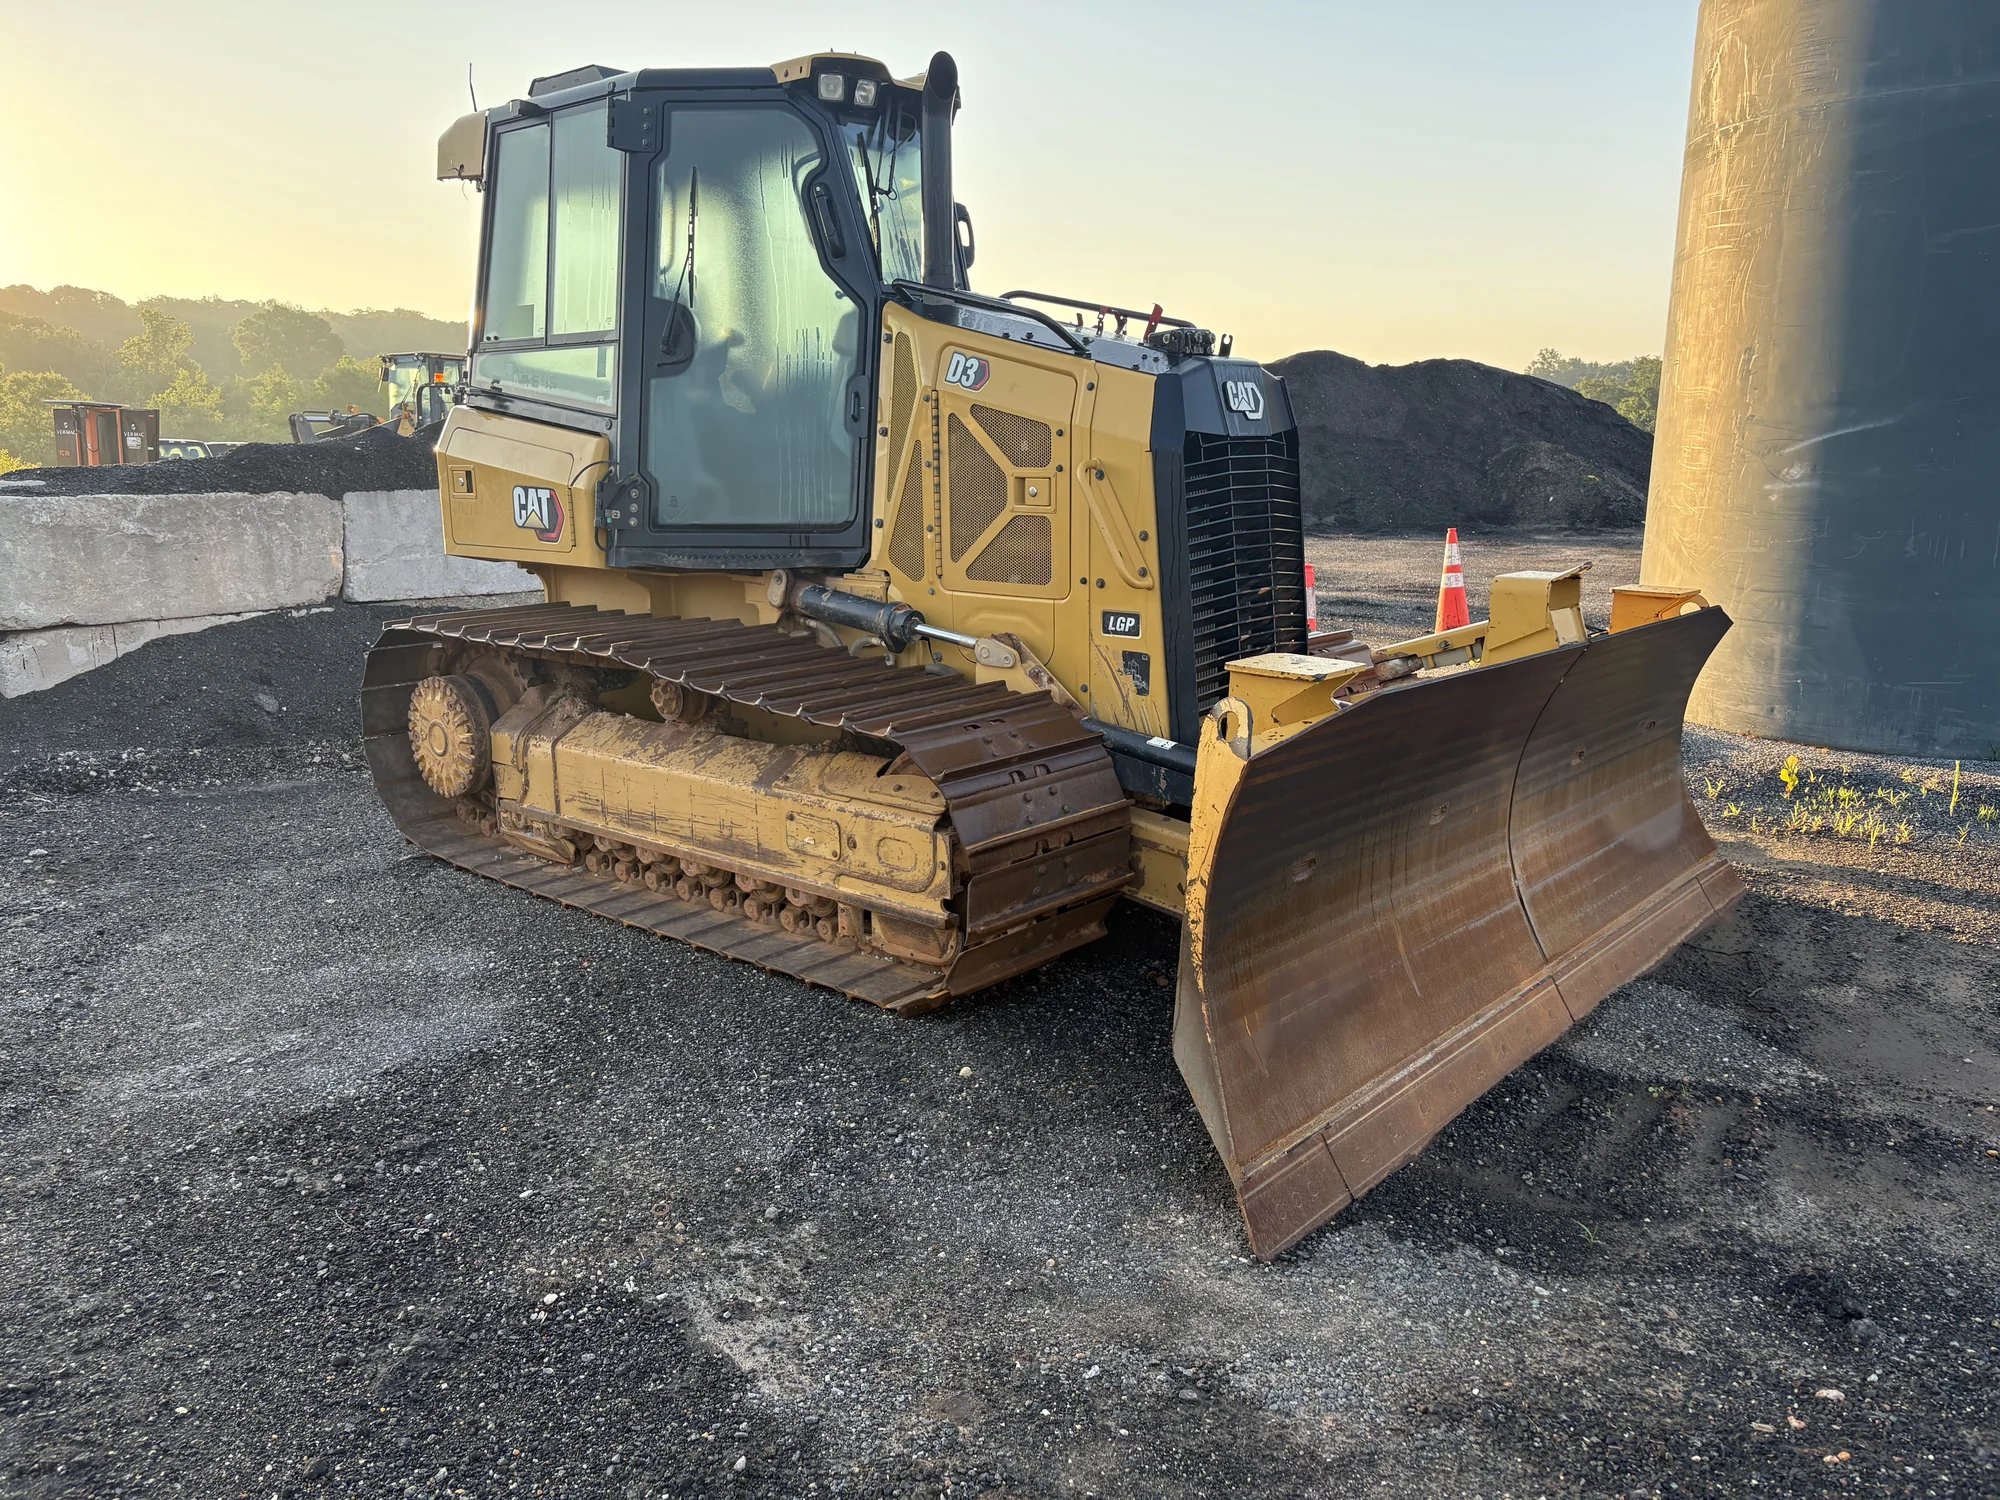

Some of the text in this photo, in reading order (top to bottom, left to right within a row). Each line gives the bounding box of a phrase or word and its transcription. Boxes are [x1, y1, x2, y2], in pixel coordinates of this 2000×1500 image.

[946, 352, 979, 387] D3
[1226, 380, 1256, 411] CAT
[513, 486, 551, 529] CAT
[1108, 615, 1136, 632] LGP
